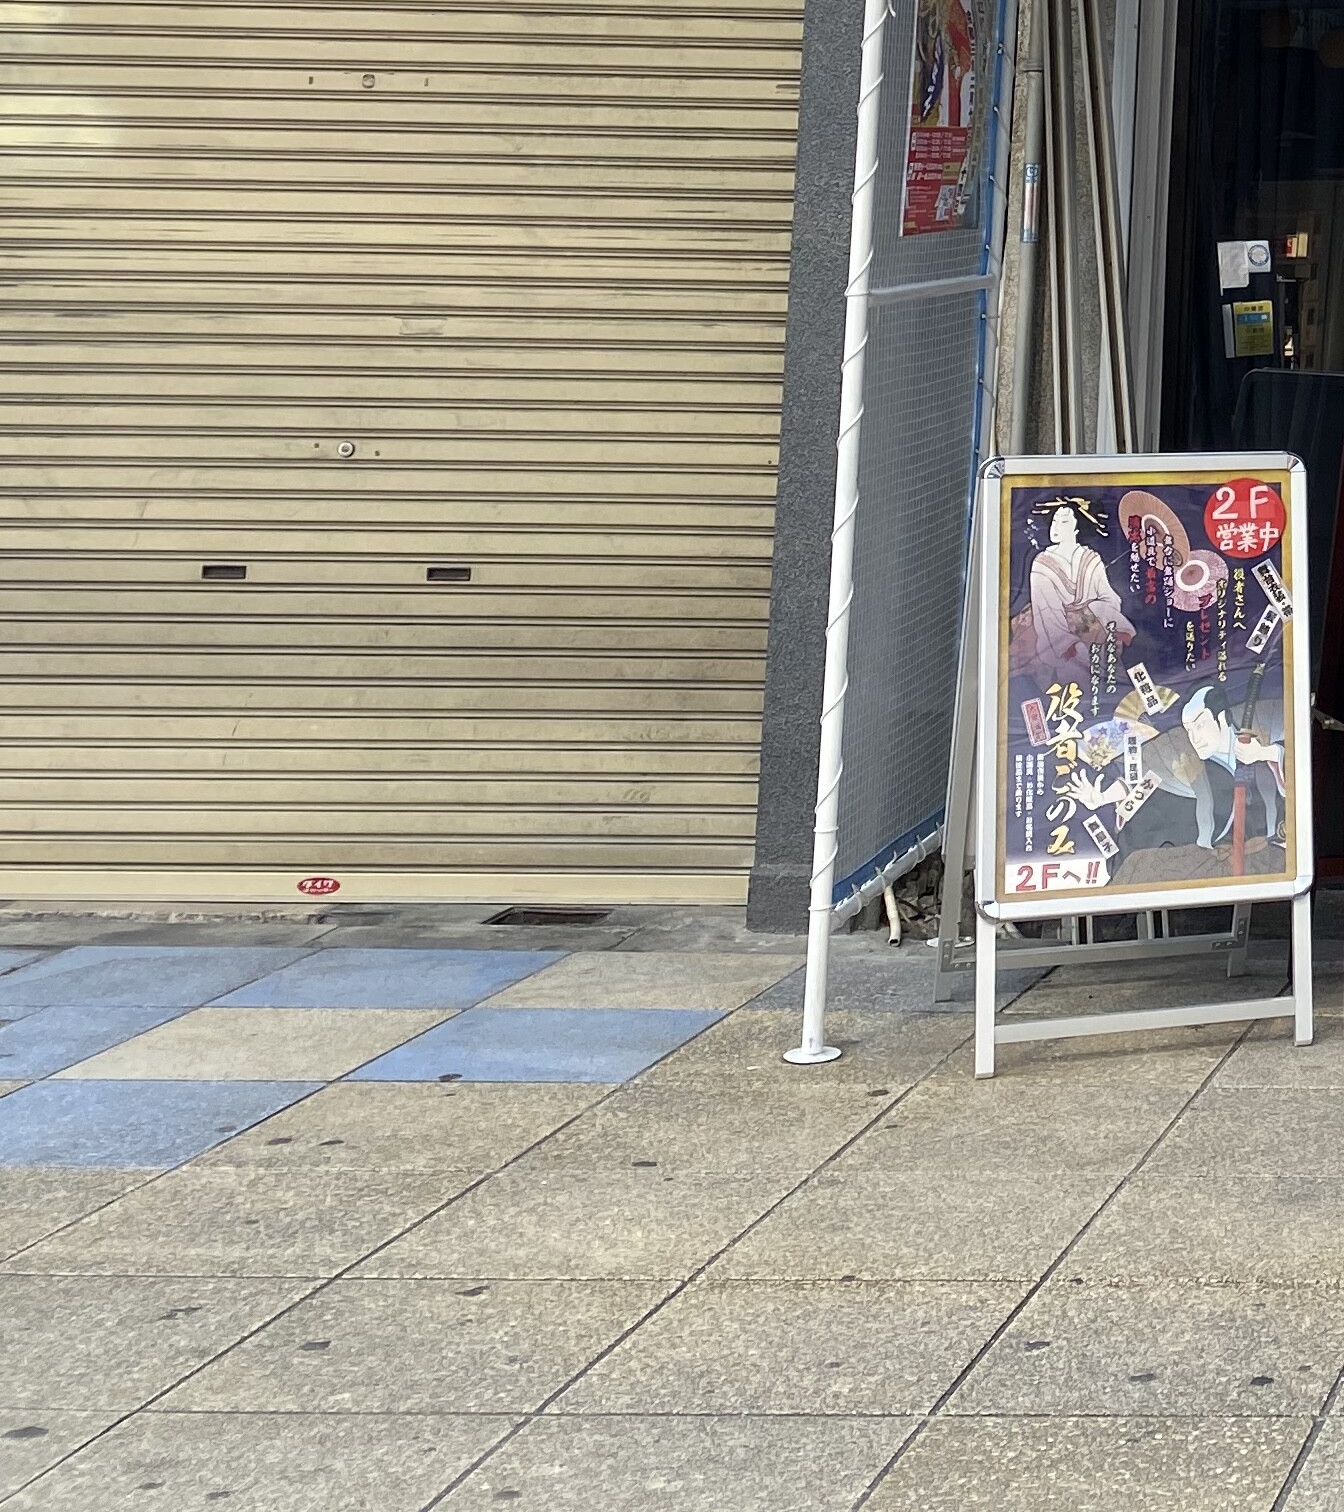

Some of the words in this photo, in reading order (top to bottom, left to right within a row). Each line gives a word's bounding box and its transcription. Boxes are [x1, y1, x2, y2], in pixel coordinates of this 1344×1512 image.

[1212, 485, 1271, 520] 2F
[1215, 521, 1282, 553] 営業中
[1044, 682, 1086, 857] 役者ごのみ
[1125, 779, 1154, 811] かつら
